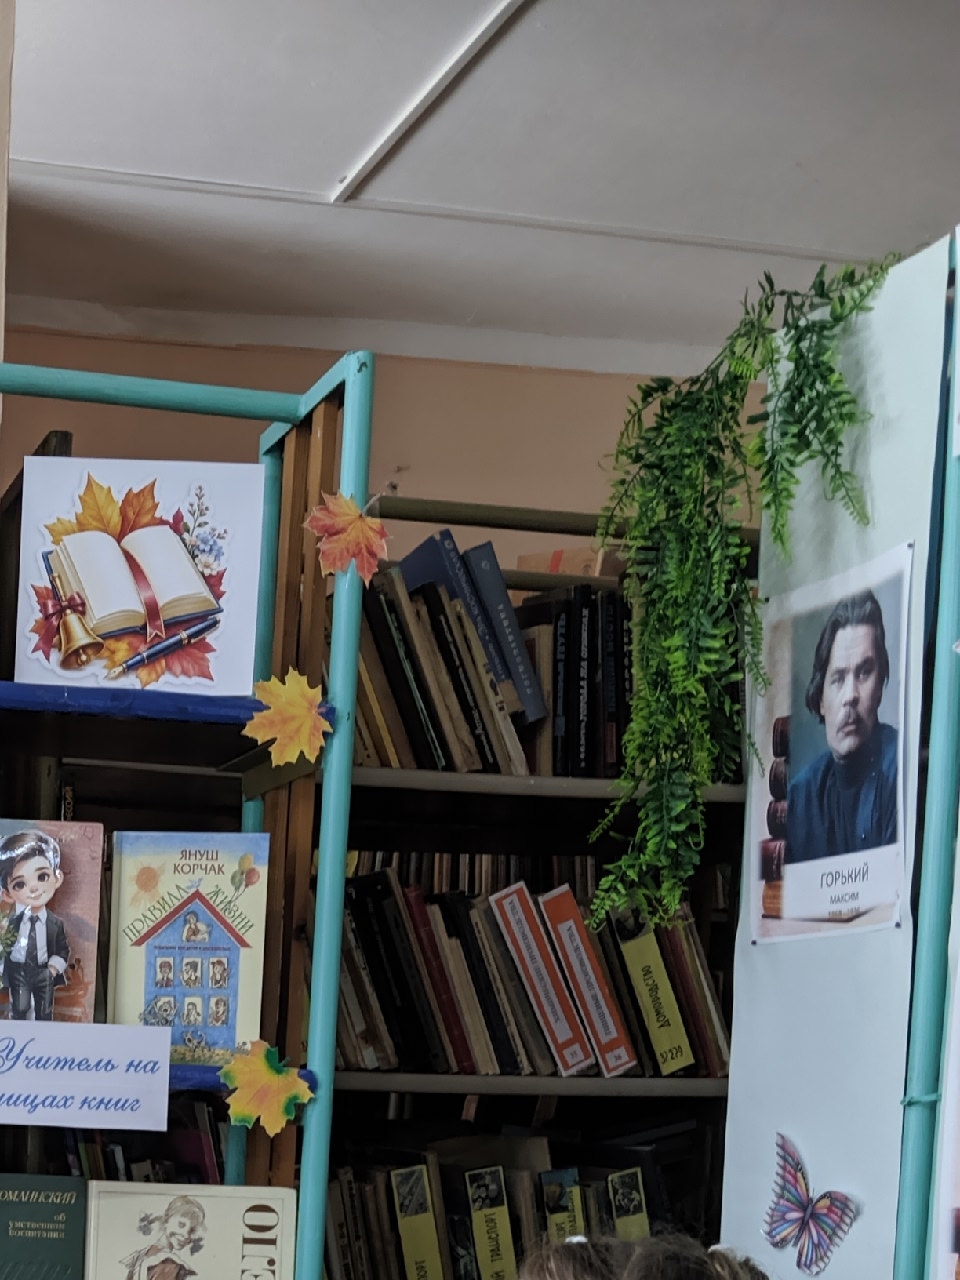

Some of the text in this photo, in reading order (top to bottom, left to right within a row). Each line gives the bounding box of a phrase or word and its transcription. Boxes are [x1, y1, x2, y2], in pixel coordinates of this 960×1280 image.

[179, 849, 219, 862] ЯНУШ
[172, 862, 226, 876] КОРЧАК
[819, 862, 870, 889] ГОРЬКИЙ
[829, 891, 860, 906] МАКСИМ
[122, 884, 256, 943] ПРАВИЛА ЖИЗНИ
[639, 963, 672, 1031] ДОМОВОДСТВО
[125, 1060, 161, 1075] на
[77, 1096, 142, 1113] книг
[53, 1211, 66, 1223] об
